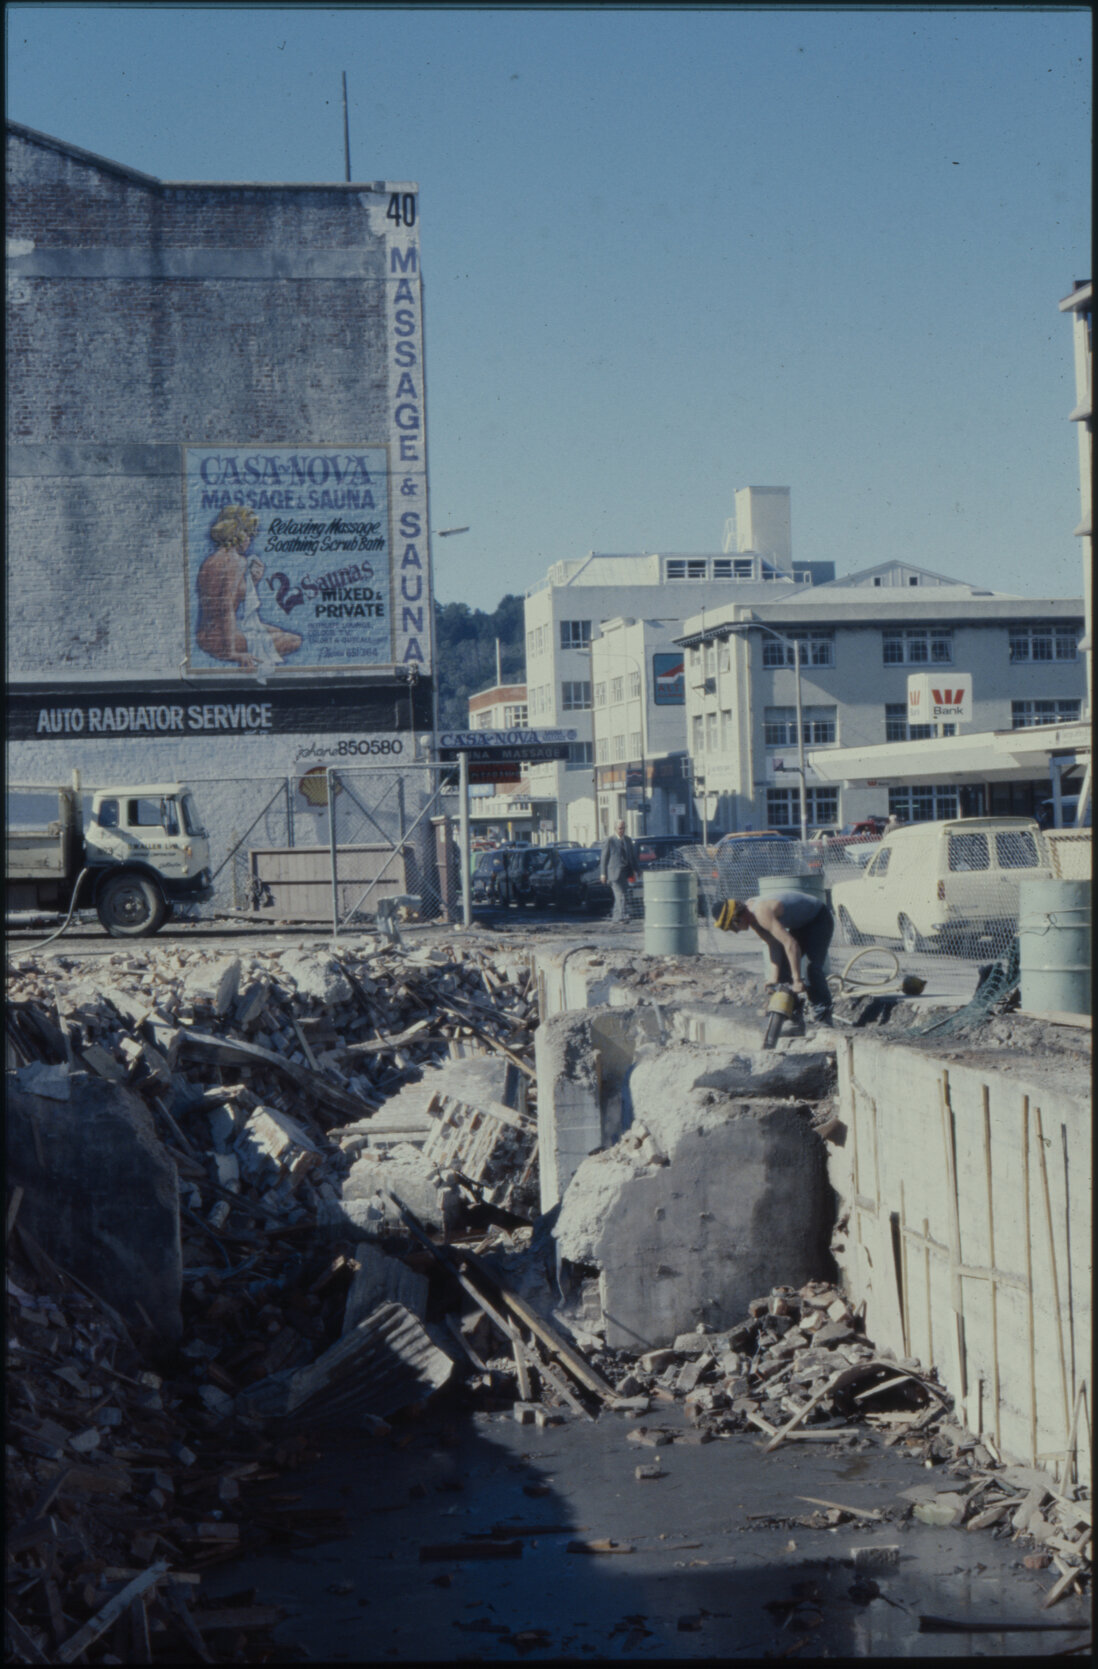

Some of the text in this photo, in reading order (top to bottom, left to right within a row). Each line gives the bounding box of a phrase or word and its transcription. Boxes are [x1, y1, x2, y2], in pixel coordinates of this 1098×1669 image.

[387, 192, 416, 227] 40
[390, 246, 424, 663] MASSAGE & SAUNA
[201, 489, 297, 510] MASSAGE
[308, 488, 376, 510] SAUNA
[268, 517, 381, 539] Relaxing Massage
[264, 535, 385, 556] Soothing Scrub Bath
[266, 560, 374, 615] 2 Saunas
[315, 603, 385, 618] PRIVATE
[37, 703, 273, 733] AUTO RADIATOR SERVICE
[933, 706, 963, 716] Bank
[337, 740, 403, 756] 850580
[501, 748, 561, 759] MASSAGE
